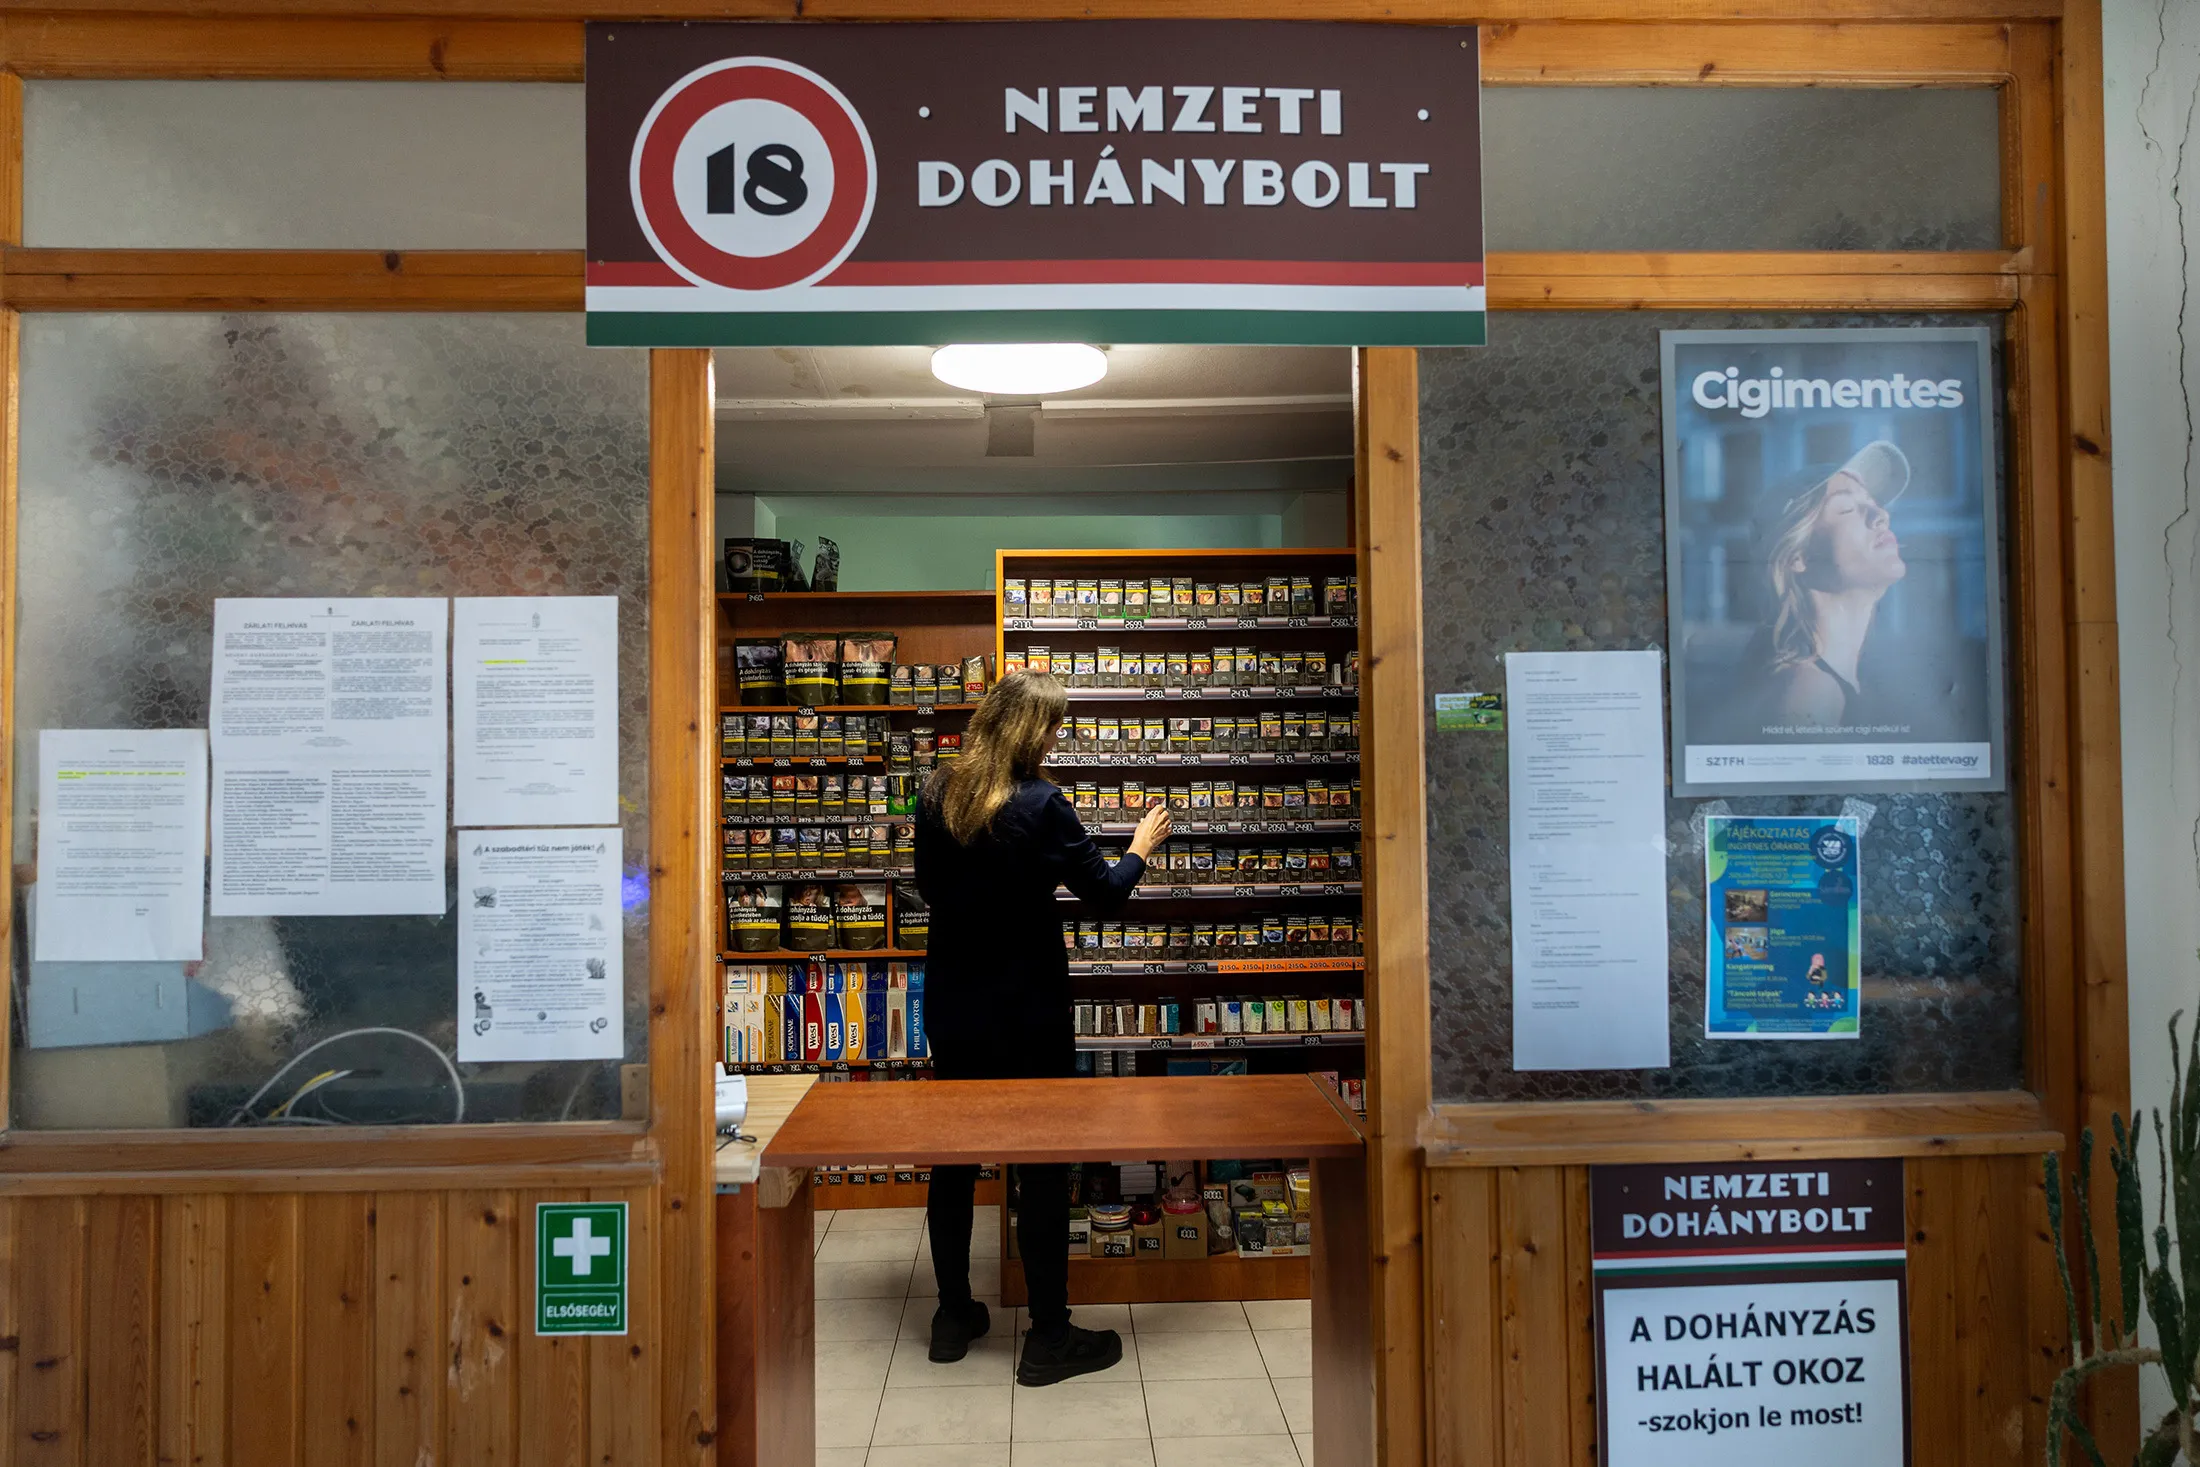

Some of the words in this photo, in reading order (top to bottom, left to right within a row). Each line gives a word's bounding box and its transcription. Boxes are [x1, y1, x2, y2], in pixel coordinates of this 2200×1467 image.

[1004, 86, 1343, 135] NEMZETI
[705, 142, 808, 216] 18
[917, 145, 1431, 209] DOHÁNYBOLT
[1692, 366, 1963, 418] Cigimentes
[1706, 756, 1744, 767] SZTFH
[1866, 754, 1894, 766] 1828
[1902, 753, 1979, 768] #atettevagy
[1727, 825, 1810, 839] TÁJÉKOZTATÁS
[492, 844, 536, 853] szabadtéri
[1727, 842, 1769, 851] INGYENES
[790, 906, 817, 915] ohányzás
[840, 906, 872, 914] dohányzás
[830, 1024, 838, 1047] West
[1664, 1171, 1830, 1201] NEMZETI
[1622, 1205, 1873, 1239] DOHÁNYBOLT
[546, 1303, 617, 1318] ELSŐSEGÉLY
[1629, 1316, 1651, 1342] A
[1664, 1299, 1875, 1341] DOHÁNYZÁS
[1637, 1354, 1762, 1391] HALÁLT
[1773, 1357, 1865, 1386] OKOZ
[1638, 1409, 1749, 1435] -szokjon
[1760, 1406, 1781, 1427] le
[1790, 1402, 1863, 1426] most!
